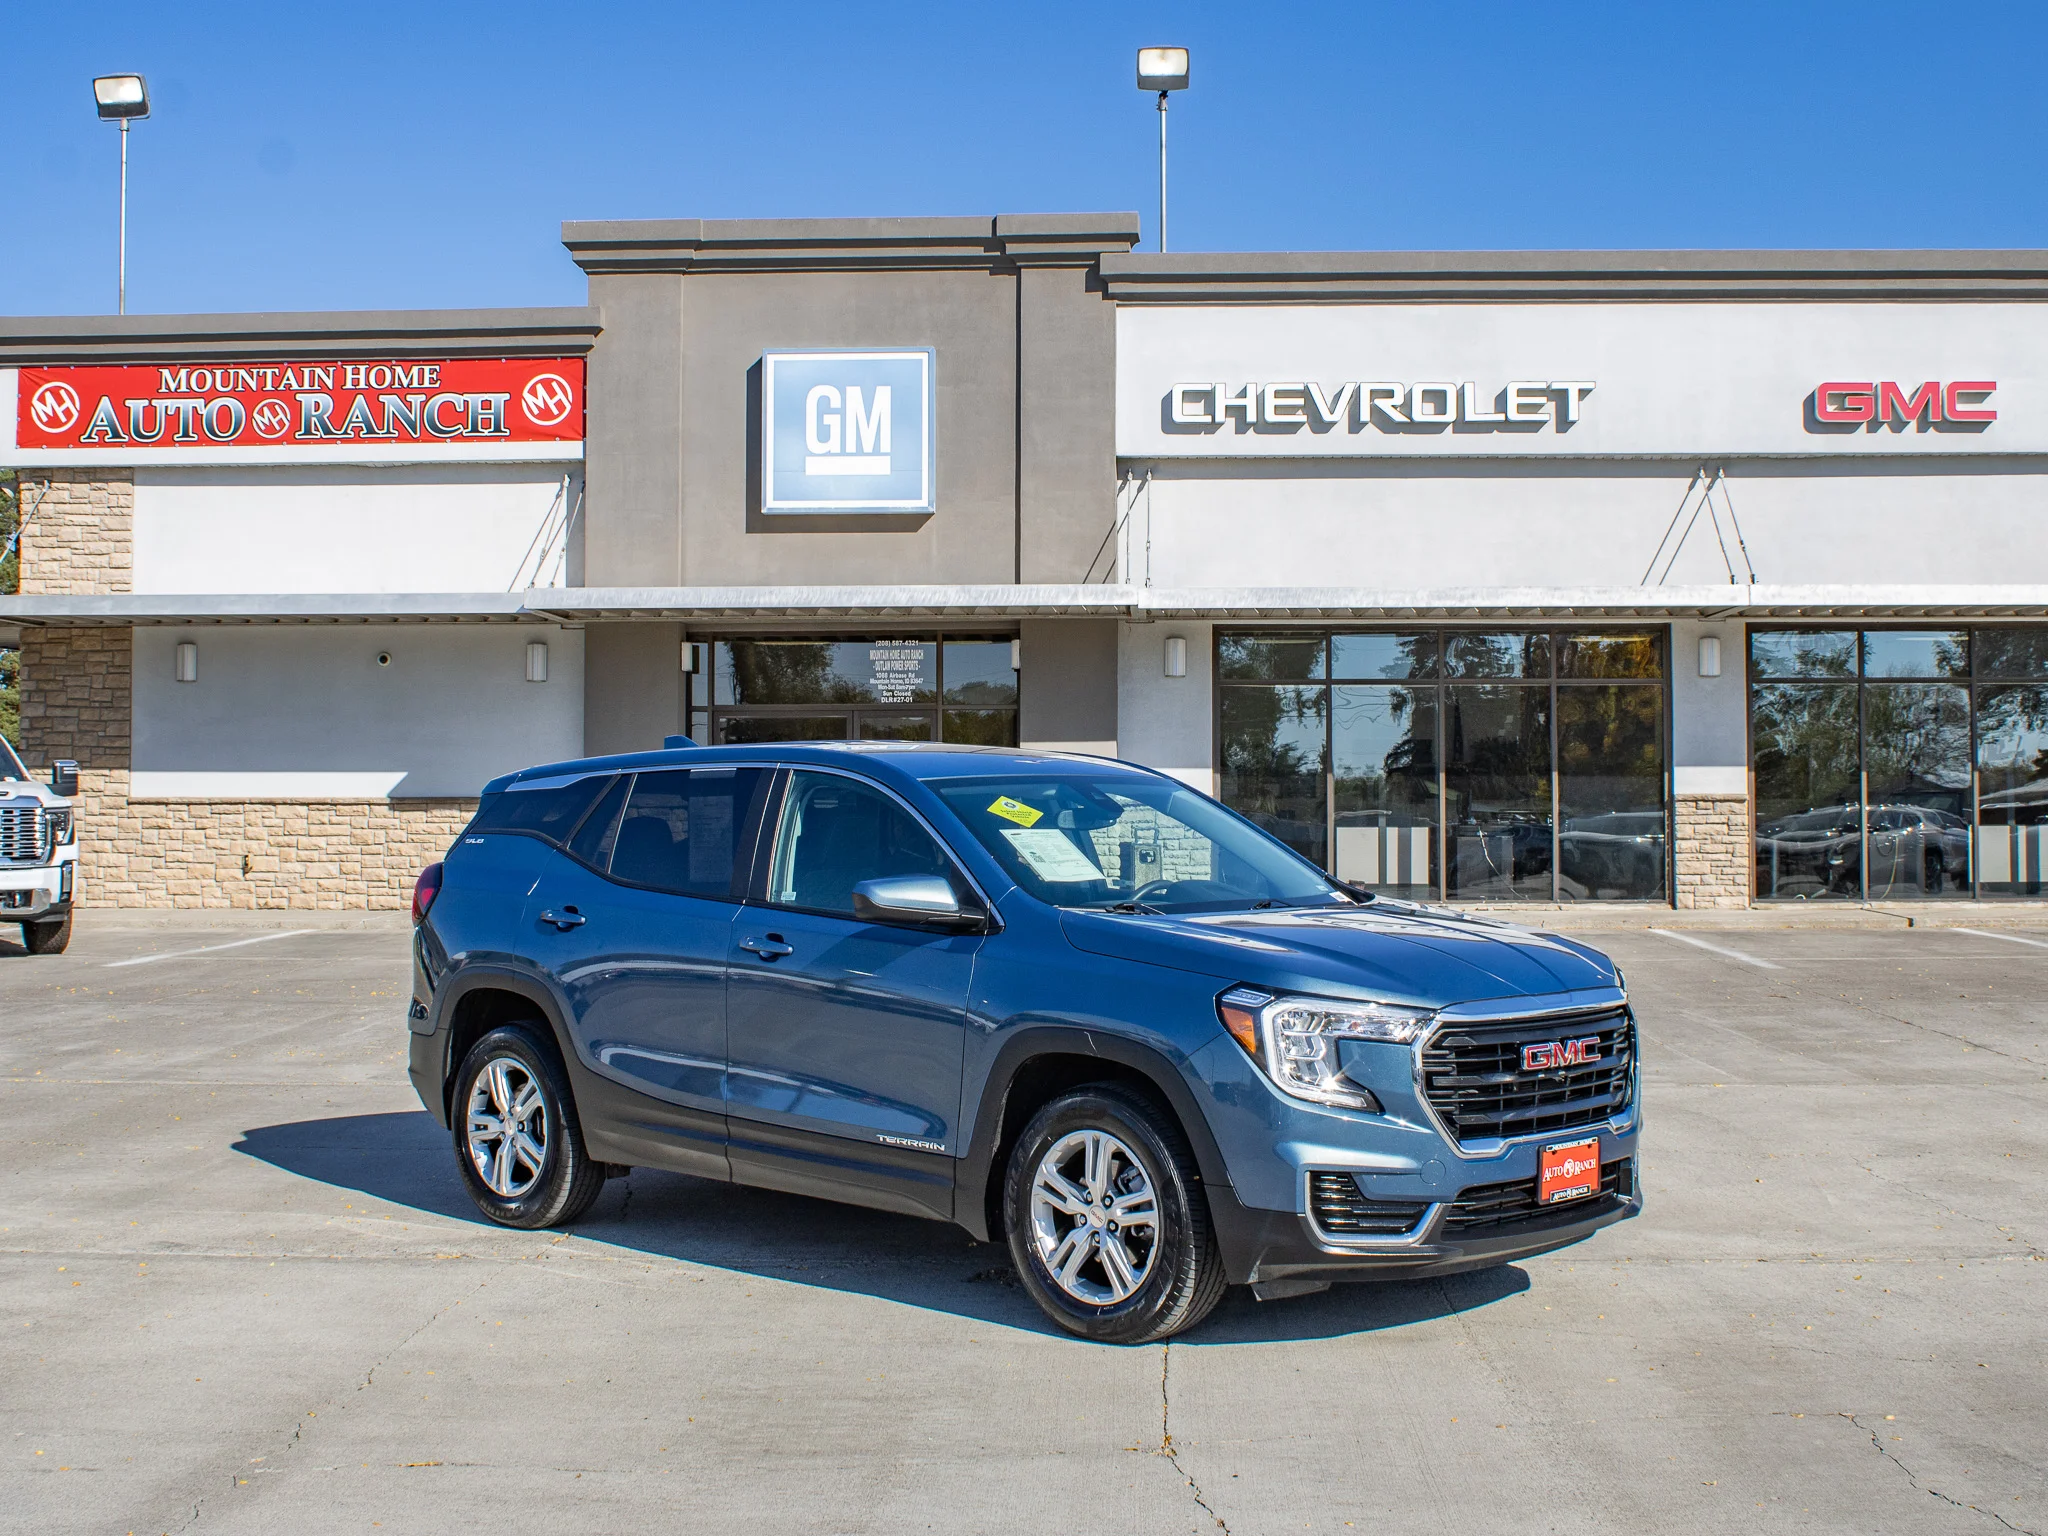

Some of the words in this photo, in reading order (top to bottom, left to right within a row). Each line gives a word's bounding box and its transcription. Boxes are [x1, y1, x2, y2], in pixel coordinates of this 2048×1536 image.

[157, 365, 336, 394] MOUNTAIN
[342, 364, 442, 391] HOME
[1171, 381, 1597, 424] CHEVROLET
[1814, 380, 1998, 423] GMC
[79, 395, 247, 443] AUTO
[294, 392, 511, 440] RANCH
[805, 384, 892, 455] GM
[869, 649, 890, 660] MOUNTAIN
[889, 649, 901, 660] HOME
[900, 649, 911, 660] AUTO
[910, 649, 924, 660] RANCH
[875, 660, 890, 671] OUTLAW
[890, 660, 904, 671] POWER
[903, 660, 919, 671] SPORTS
[1521, 1036, 1602, 1070] GMC
[876, 1133, 946, 1152] TERRAIN
[1542, 1165, 1564, 1182] AUTO
[1574, 1158, 1597, 1175] RANCH
[1552, 1191, 1567, 1200] AUTO
[1570, 1186, 1589, 1197] RANCH
